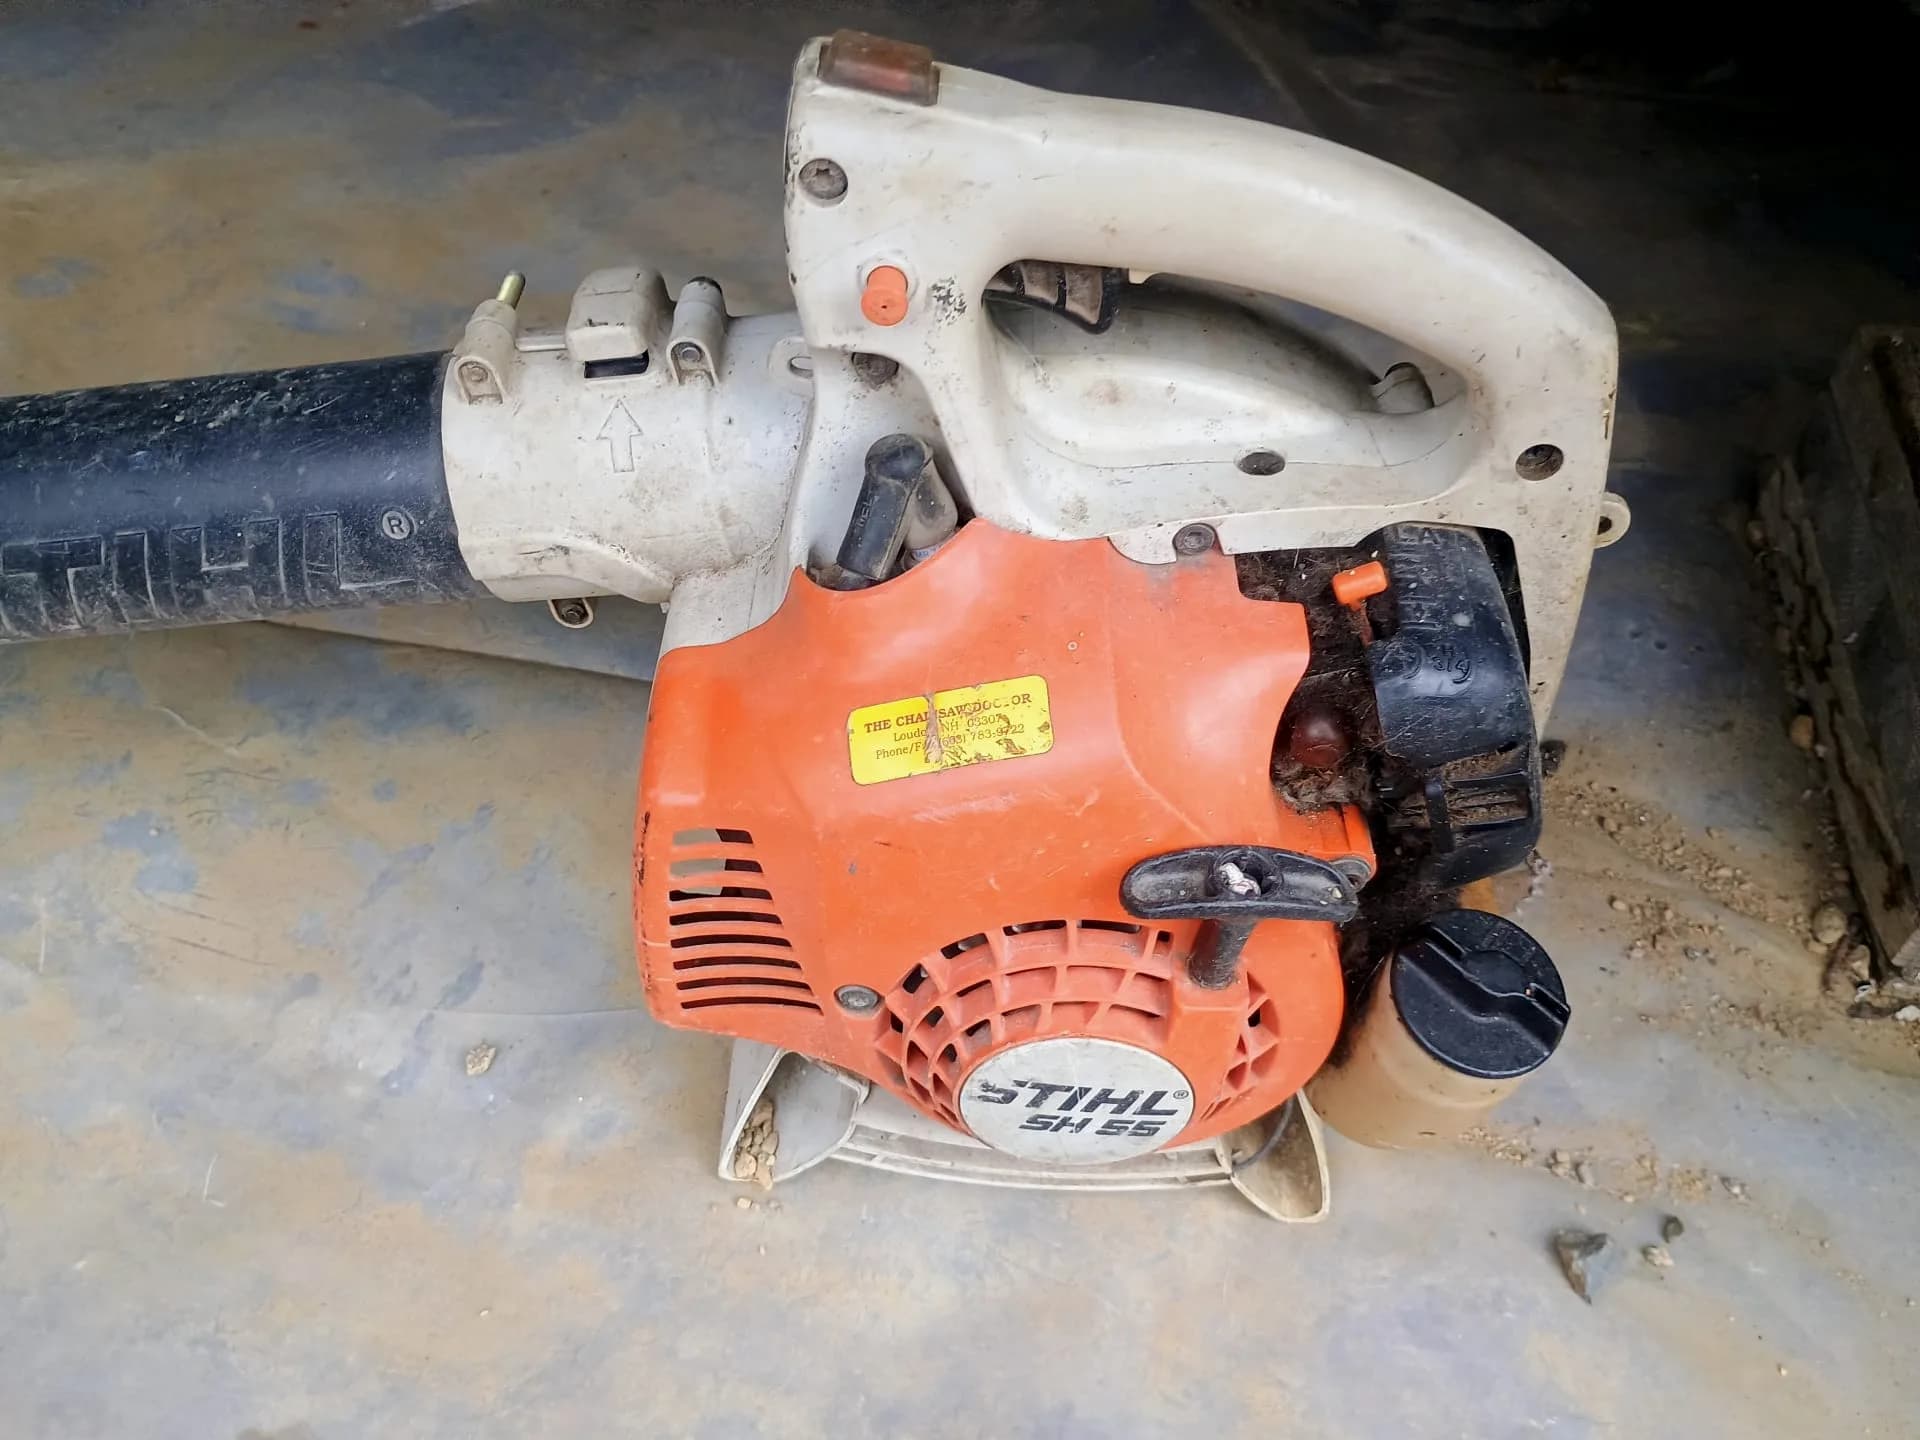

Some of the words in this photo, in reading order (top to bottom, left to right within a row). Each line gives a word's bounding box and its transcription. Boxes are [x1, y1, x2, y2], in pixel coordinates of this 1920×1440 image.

[864, 719, 892, 734] THE
[895, 706, 968, 728] CHAISAW
[1019, 1114, 1092, 1134] SH
[1095, 1118, 1168, 1137] 55
